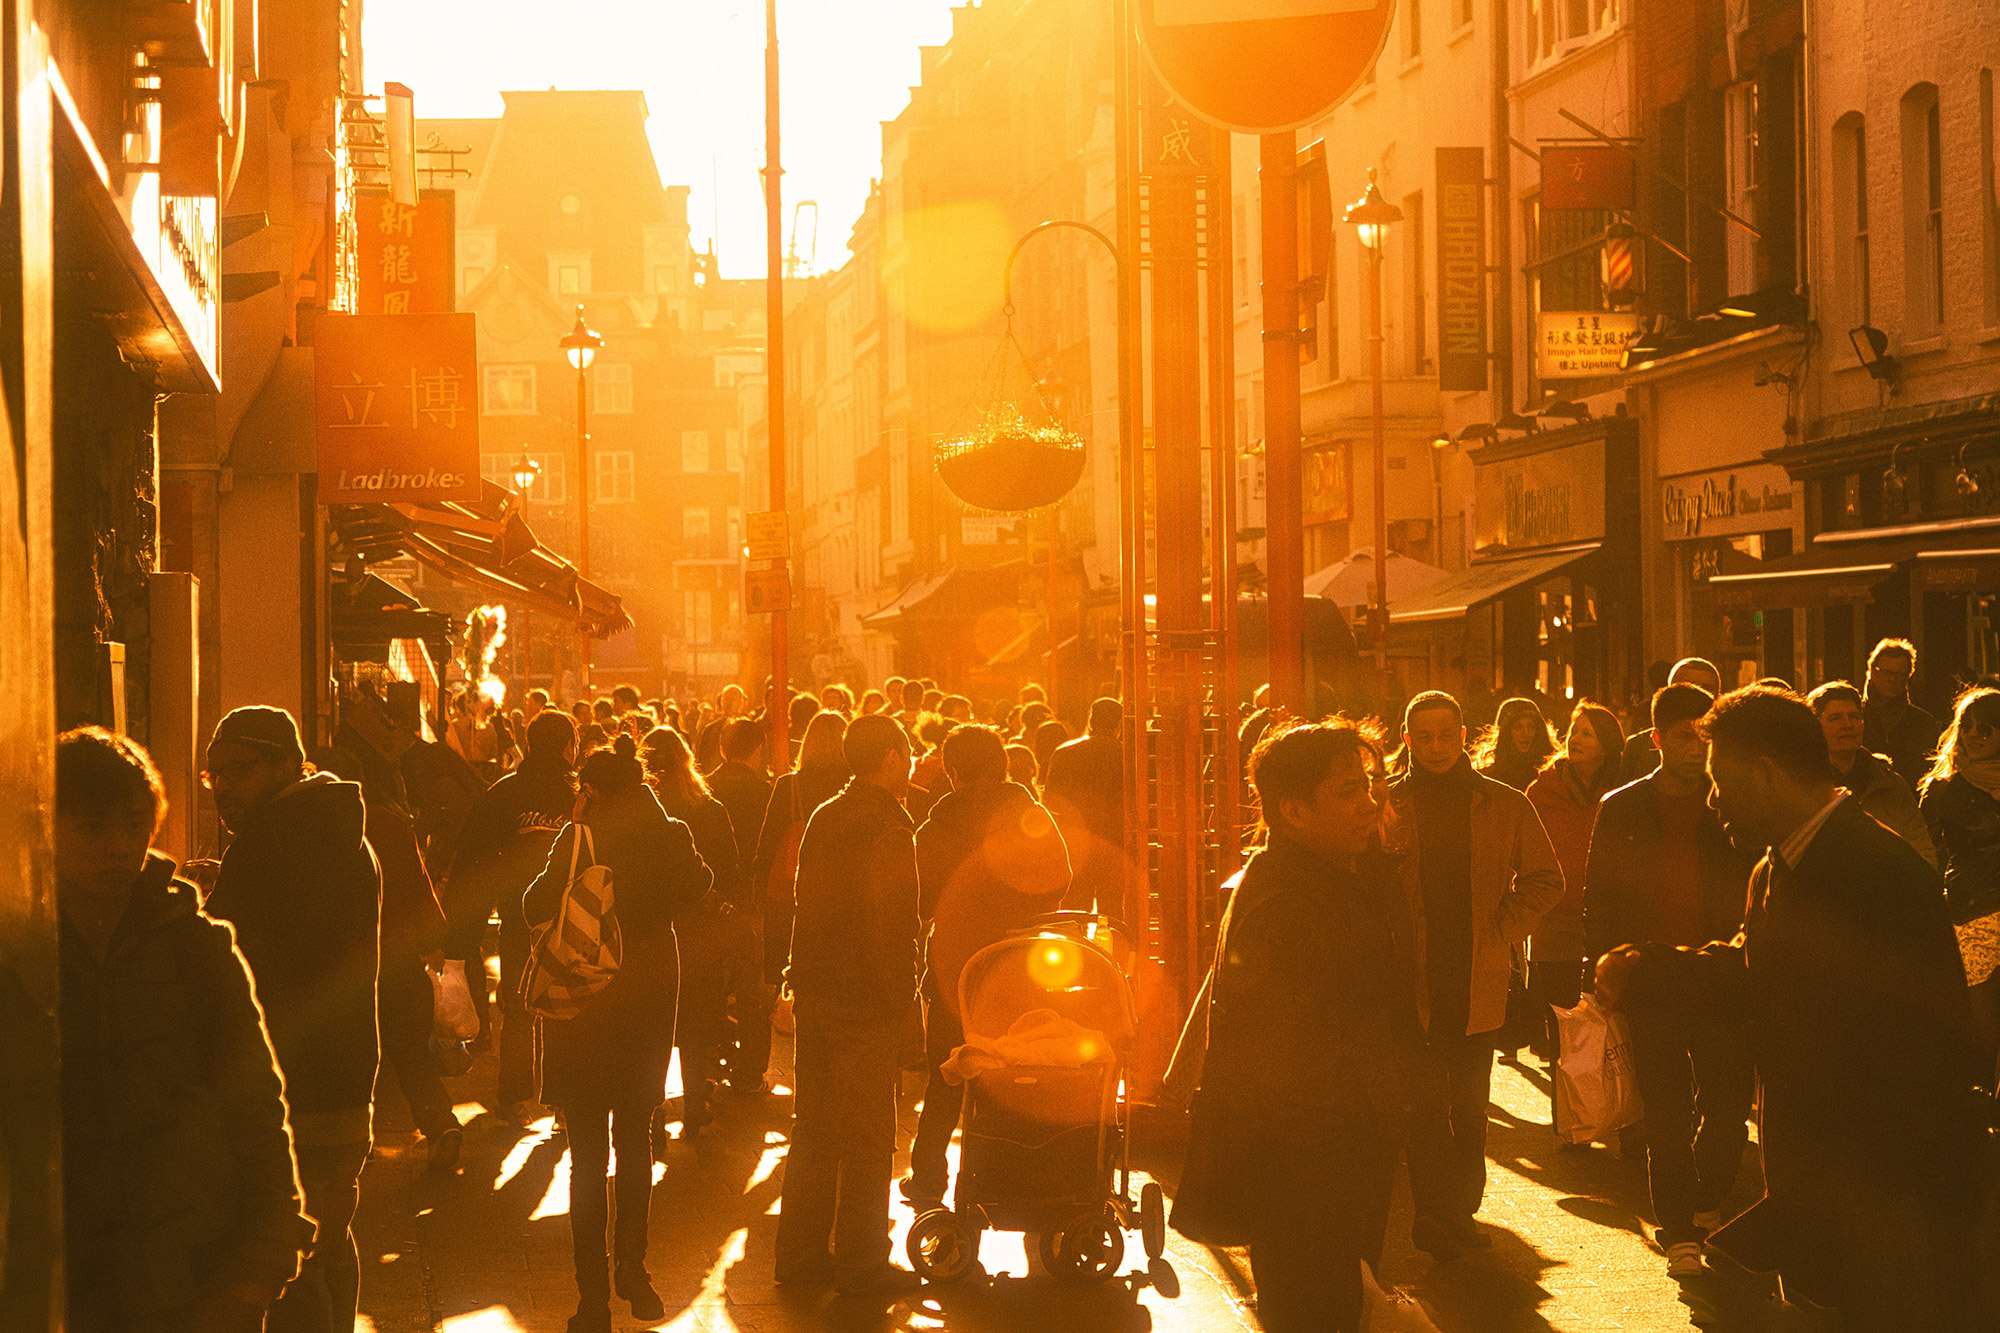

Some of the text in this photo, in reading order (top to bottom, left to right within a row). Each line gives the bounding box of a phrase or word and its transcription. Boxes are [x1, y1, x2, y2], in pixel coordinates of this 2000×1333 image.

[1445, 220, 1480, 354] HAOZHAN
[1547, 347, 1622, 357] Image Hair Desi
[328, 365, 467, 430] 立博
[337, 467, 466, 492] Ladbrokes
[1663, 484, 1701, 535] Crispy
[1701, 474, 1735, 518] Duck
